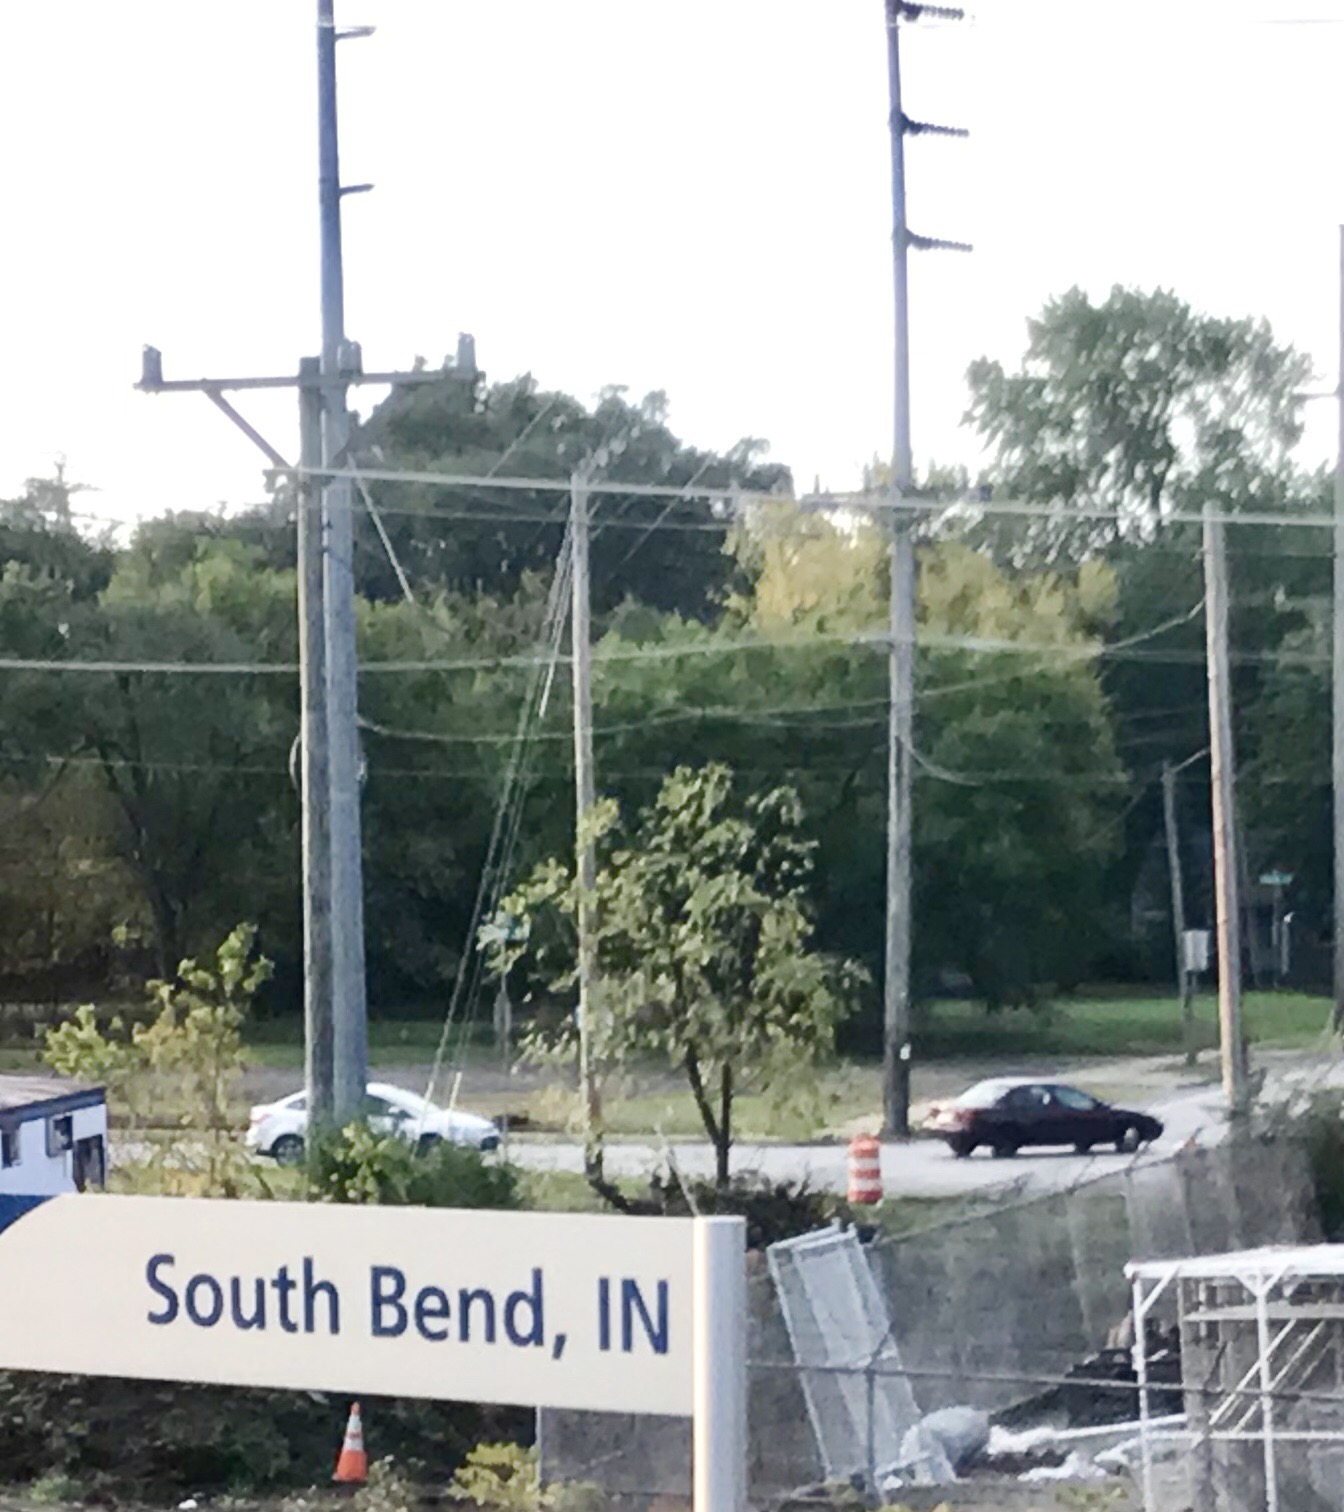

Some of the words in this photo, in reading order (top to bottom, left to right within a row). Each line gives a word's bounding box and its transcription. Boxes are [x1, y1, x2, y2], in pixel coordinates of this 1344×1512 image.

[146, 1253, 341, 1336] South
[370, 1265, 568, 1361] Bend,
[598, 1277, 669, 1356] IN
